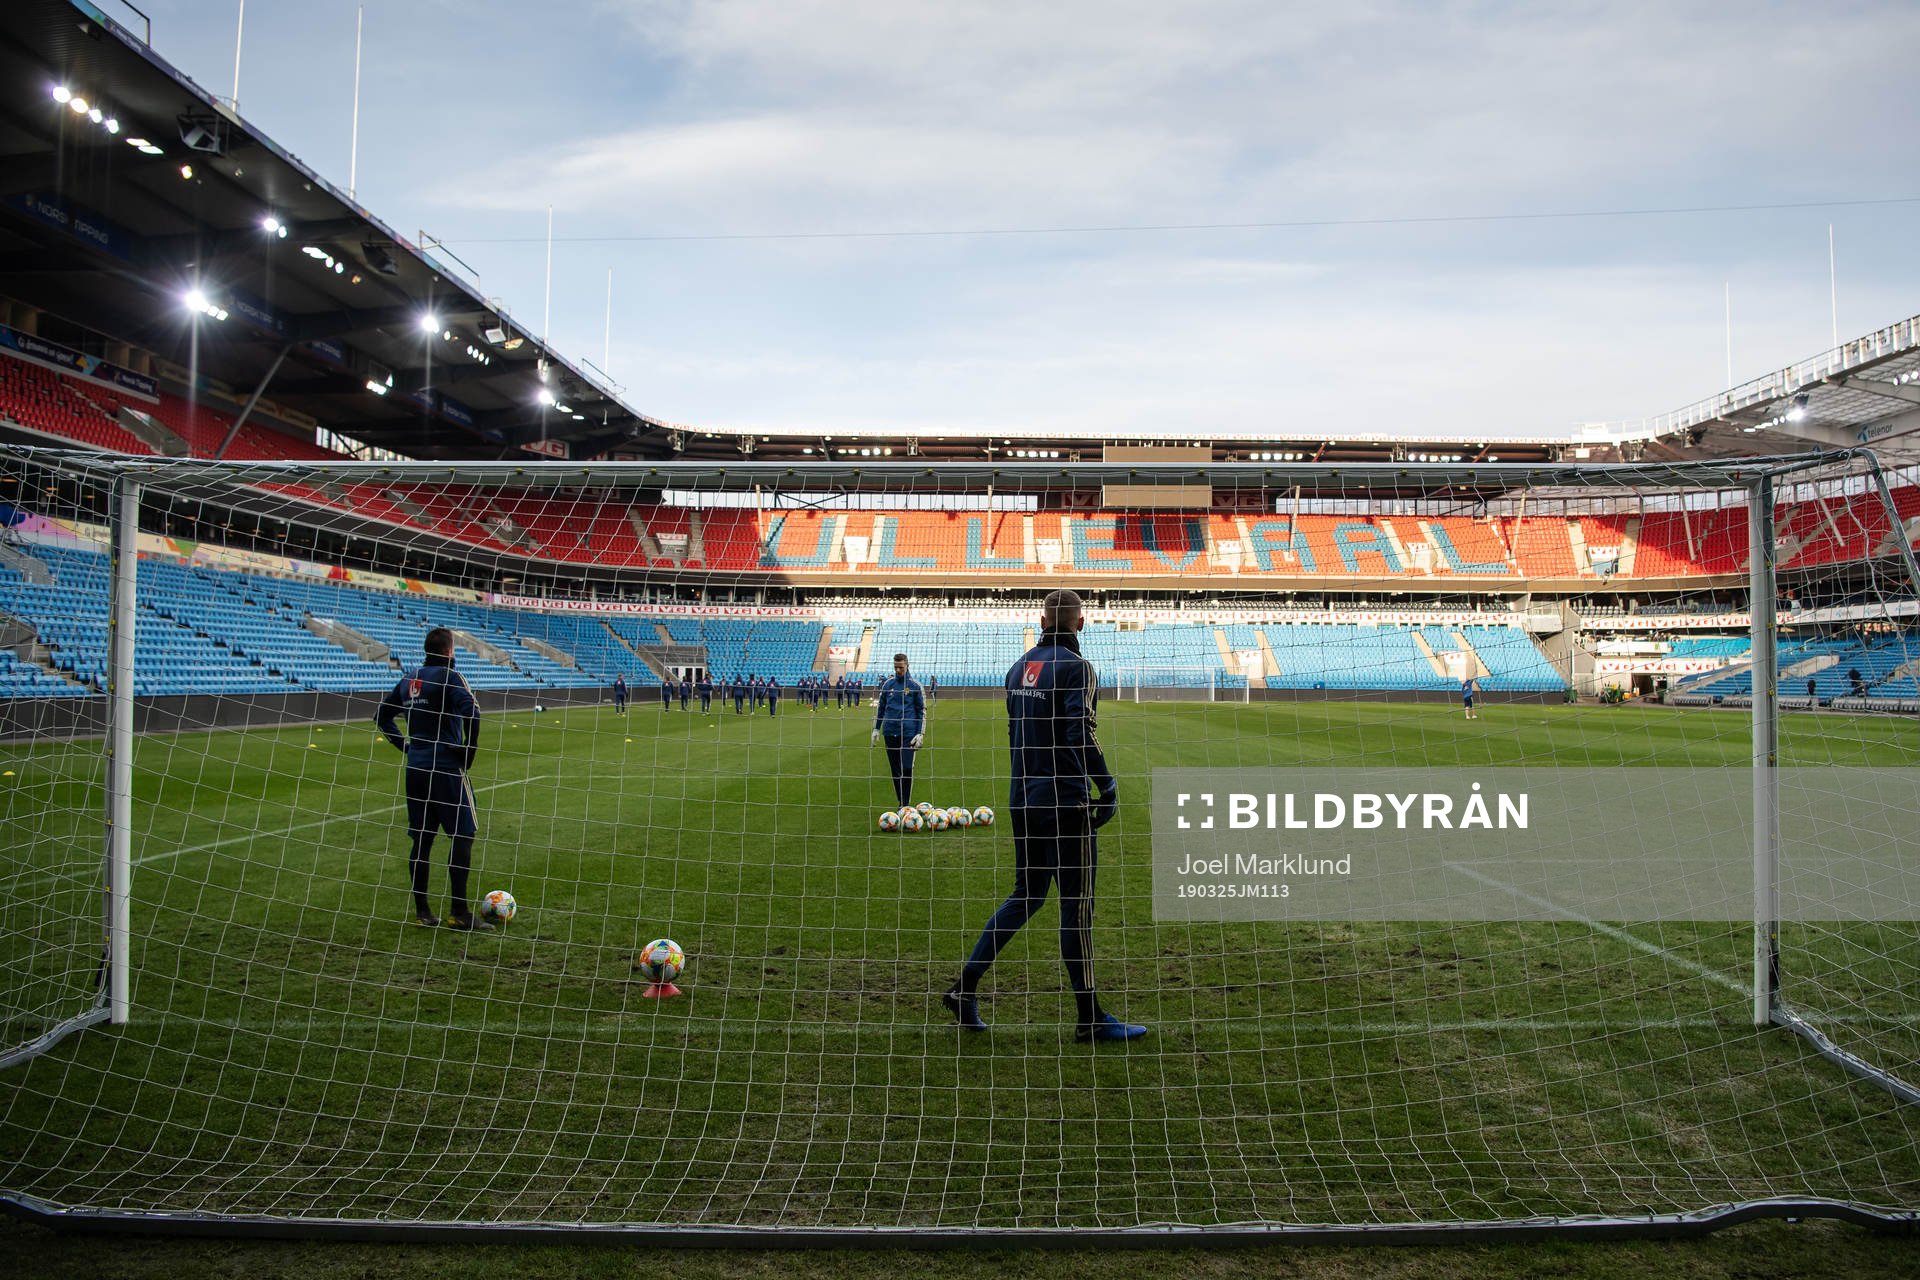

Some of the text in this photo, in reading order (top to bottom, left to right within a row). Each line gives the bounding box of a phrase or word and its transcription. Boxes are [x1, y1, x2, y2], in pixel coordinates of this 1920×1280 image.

[1868, 424, 1893, 438] telenor
[501, 596, 516, 605] VG
[518, 597, 539, 607] VG
[542, 598, 564, 609] VG
[568, 601, 592, 610] VG
[596, 603, 622, 612] VG
[627, 605, 654, 613] VG
[659, 606, 687, 614] VG
[692, 606, 719, 615] VG
[724, 606, 751, 615] VG
[757, 607, 783, 616] VG
[789, 607, 816, 616] VG
[1032, 690, 1047, 700] SPEL
